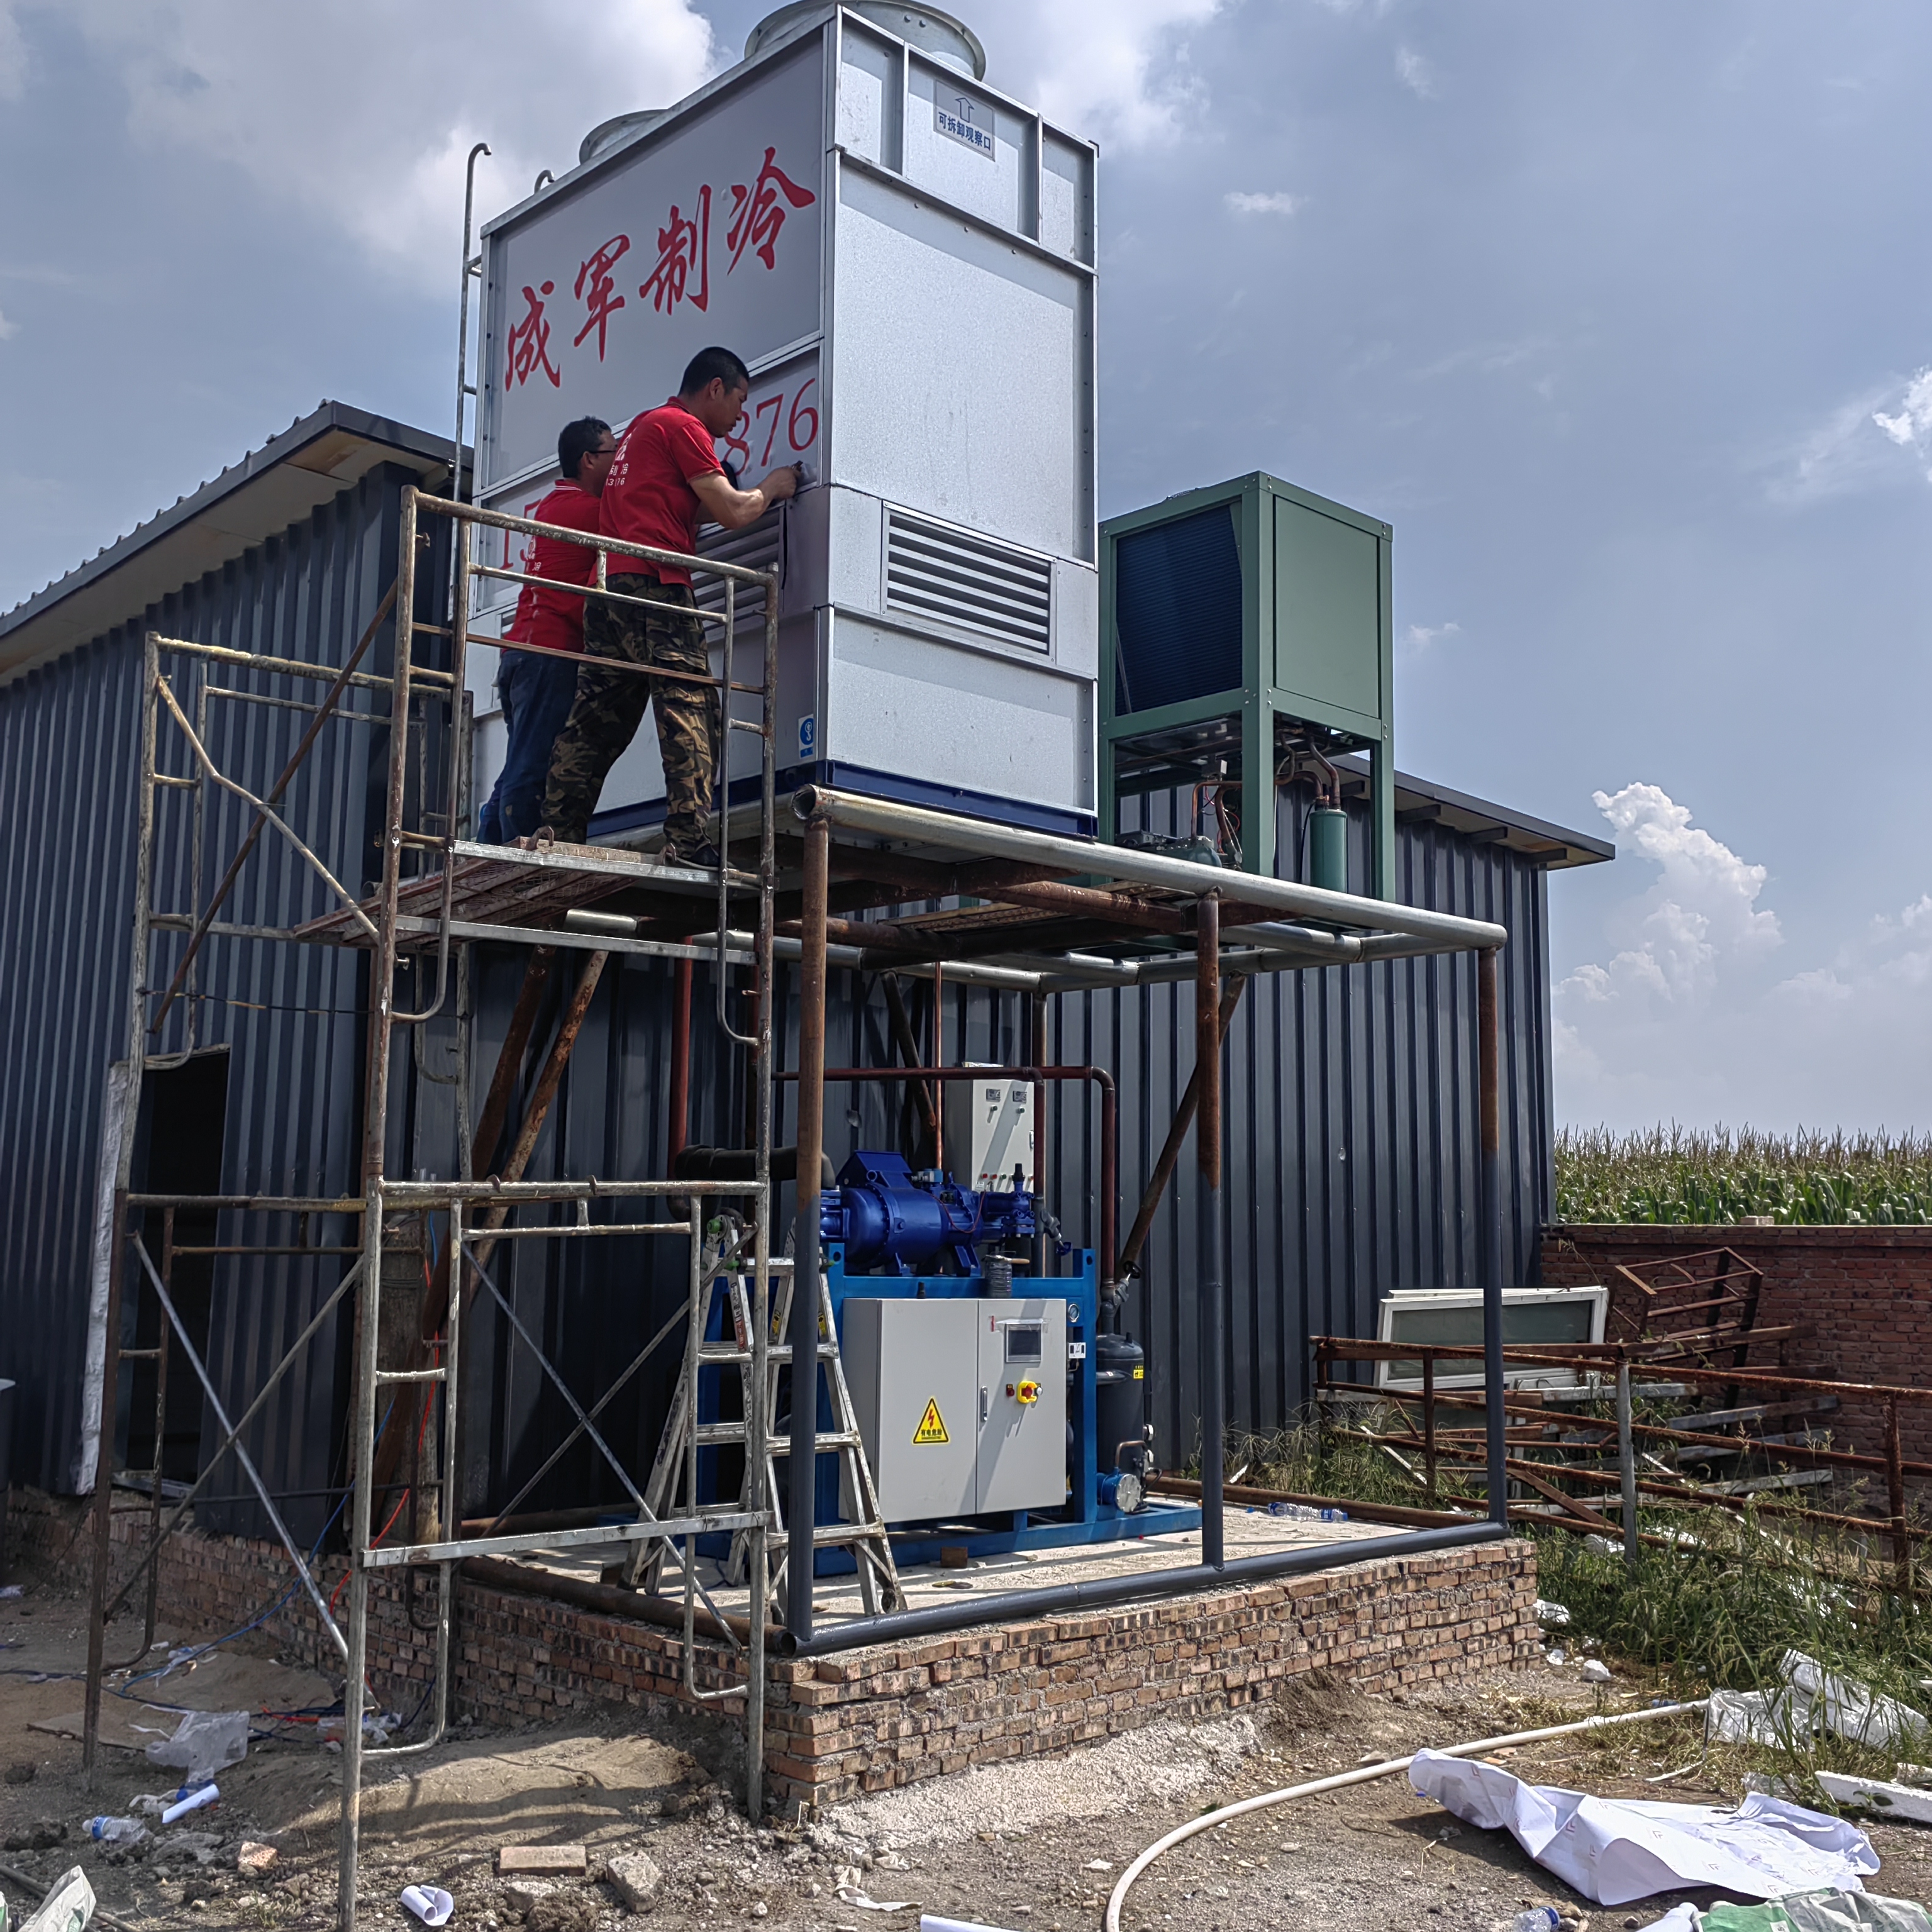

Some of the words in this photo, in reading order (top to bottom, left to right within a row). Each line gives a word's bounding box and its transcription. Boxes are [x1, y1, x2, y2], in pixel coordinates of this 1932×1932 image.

[938, 111, 991, 151] 可拆卸观察口
[505, 147, 816, 392] 成军制冷
